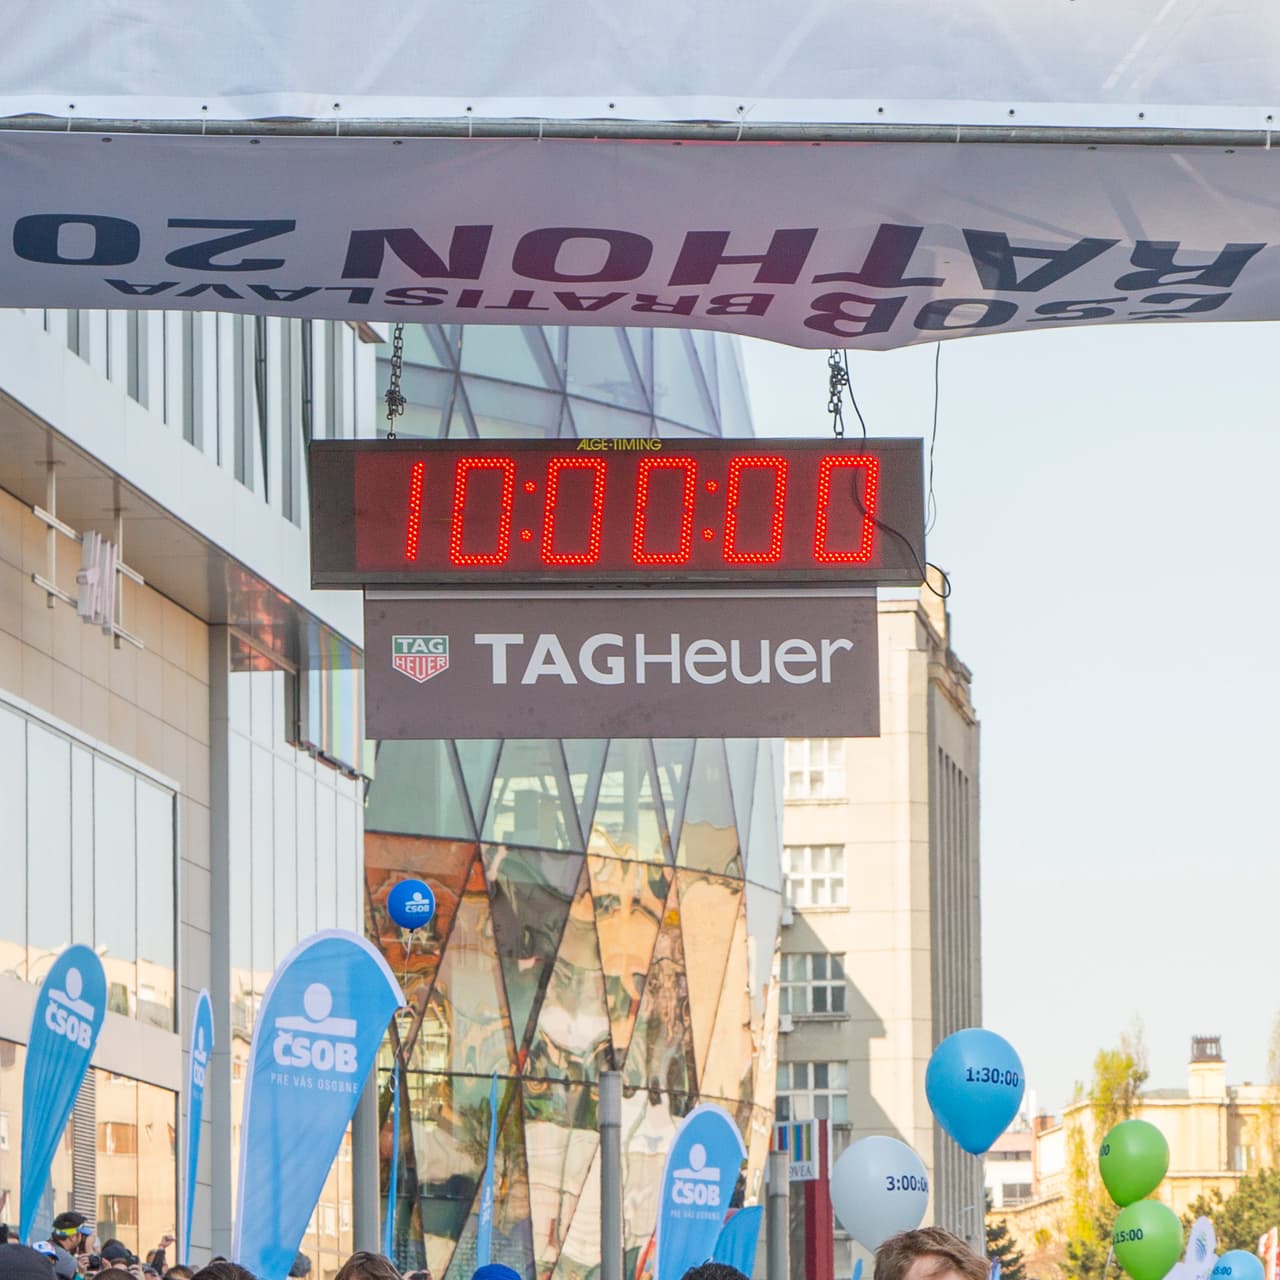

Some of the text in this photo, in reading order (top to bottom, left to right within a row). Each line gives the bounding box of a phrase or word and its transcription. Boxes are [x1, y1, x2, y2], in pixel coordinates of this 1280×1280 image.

[404, 456, 879, 565] 10:00:00
[396, 637, 445, 653] TAG
[396, 655, 447, 681] HEUER
[45, 1000, 94, 1049] ČSOB
[273, 1030, 358, 1073] ČSOB
[965, 1066, 1019, 1088] 1:30:00
[672, 1180, 721, 1206] ČSOB
